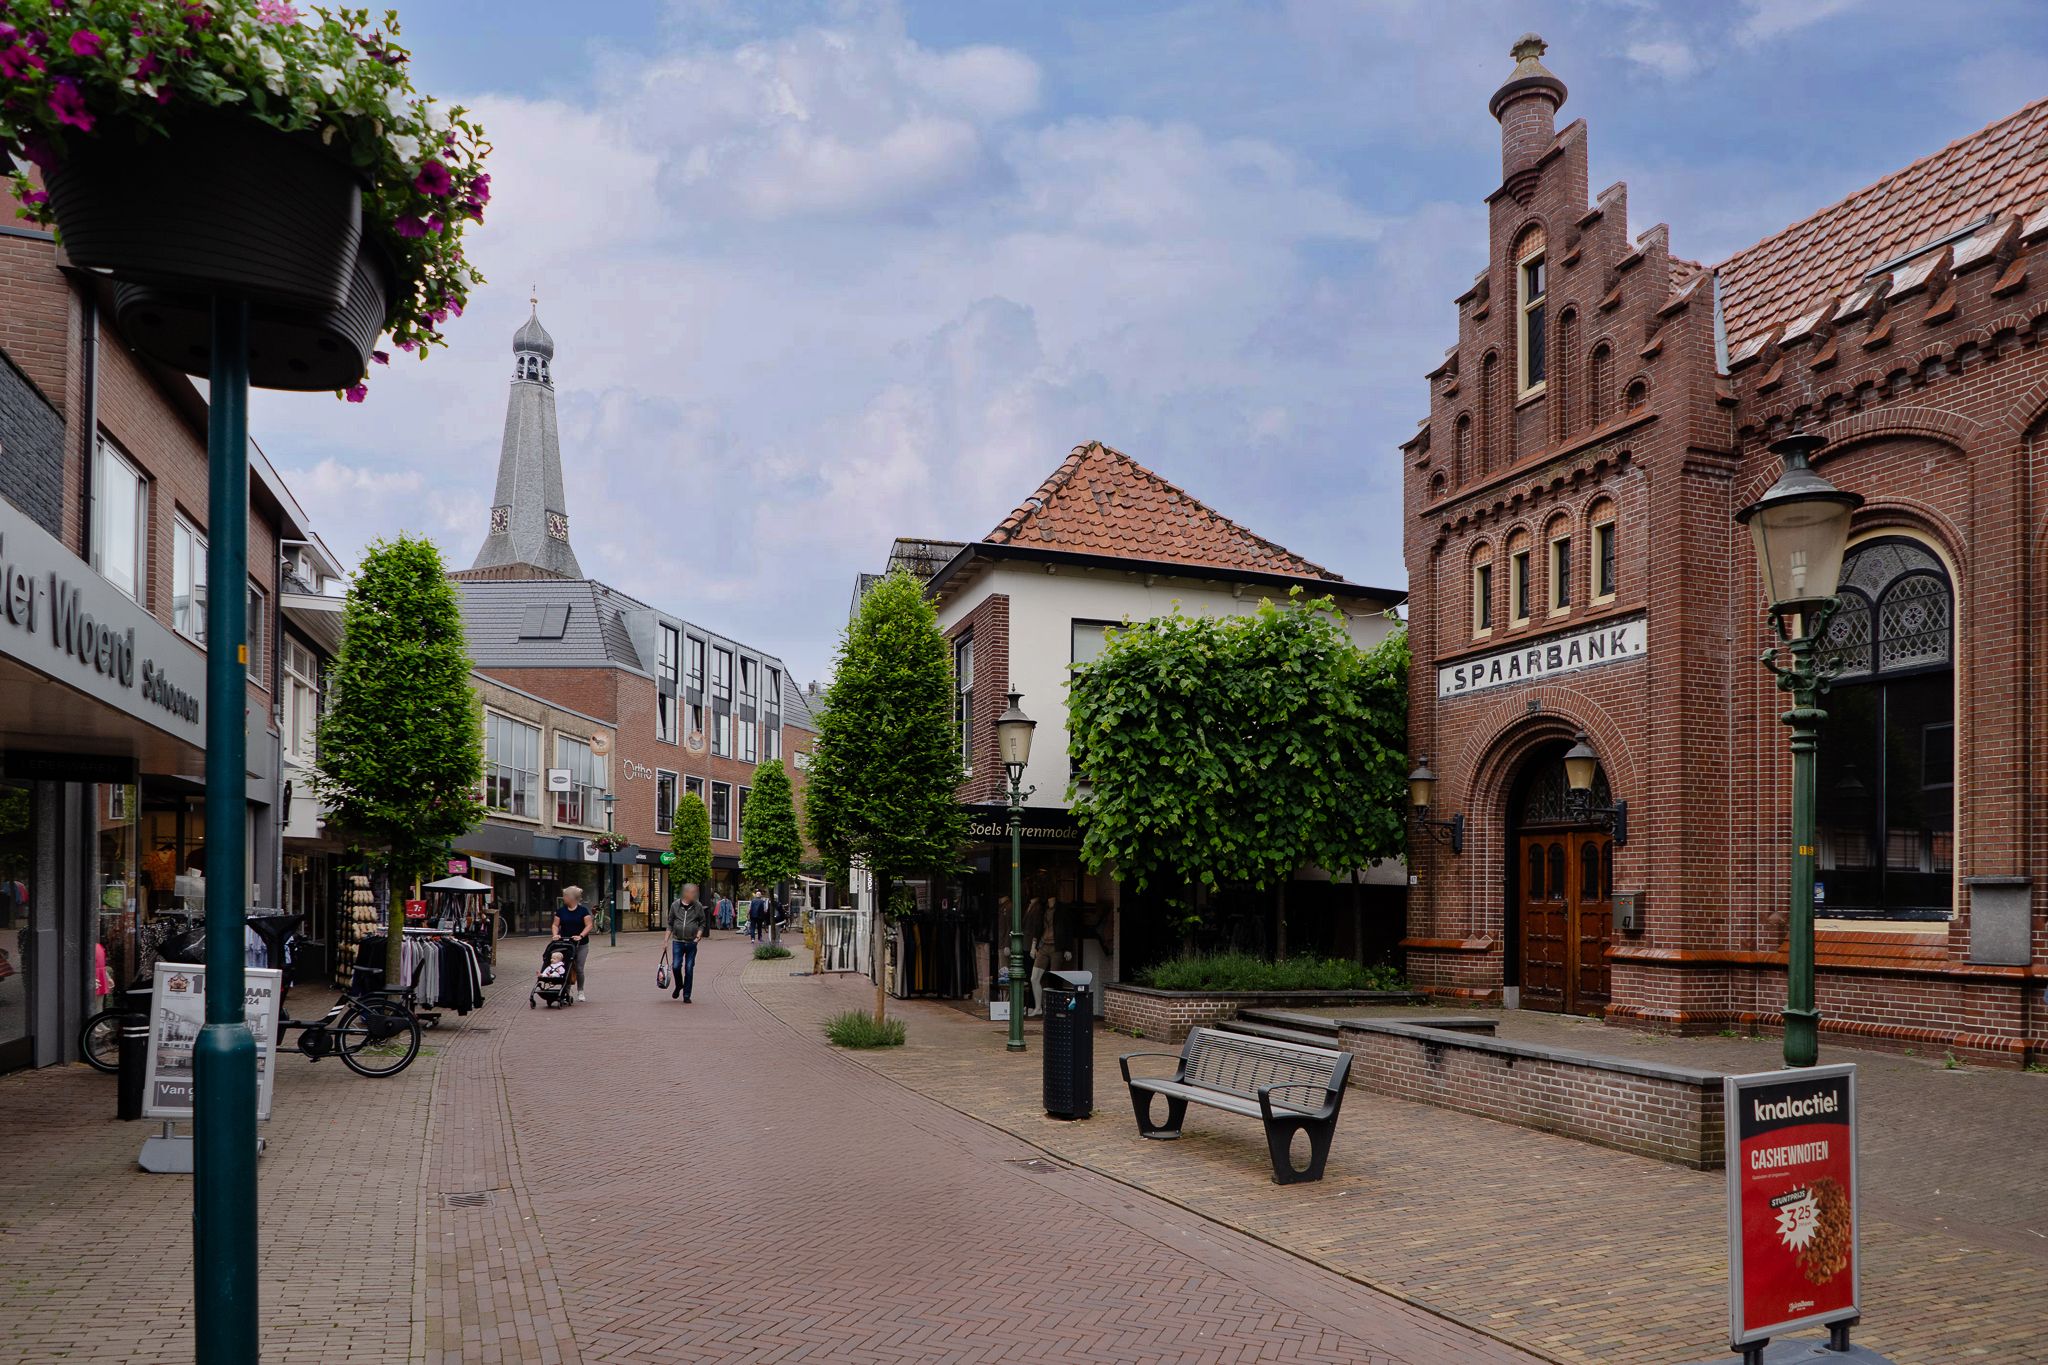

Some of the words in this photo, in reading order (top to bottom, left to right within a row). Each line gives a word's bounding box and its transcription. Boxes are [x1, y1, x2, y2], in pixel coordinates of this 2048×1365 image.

[50, 571, 136, 688] Woerd
[623, 759, 653, 780] Ortho
[969, 822, 1002, 836] Soels
[1004, 823, 1079, 839] hrenmode
[244, 987, 272, 998] AAR
[160, 1084, 185, 1095] Van
[1754, 1090, 1838, 1122] knalactie!
[1751, 1140, 1829, 1170] CASHEWNOTEN
[1771, 1189, 1806, 1207] STUNTPRIJS
